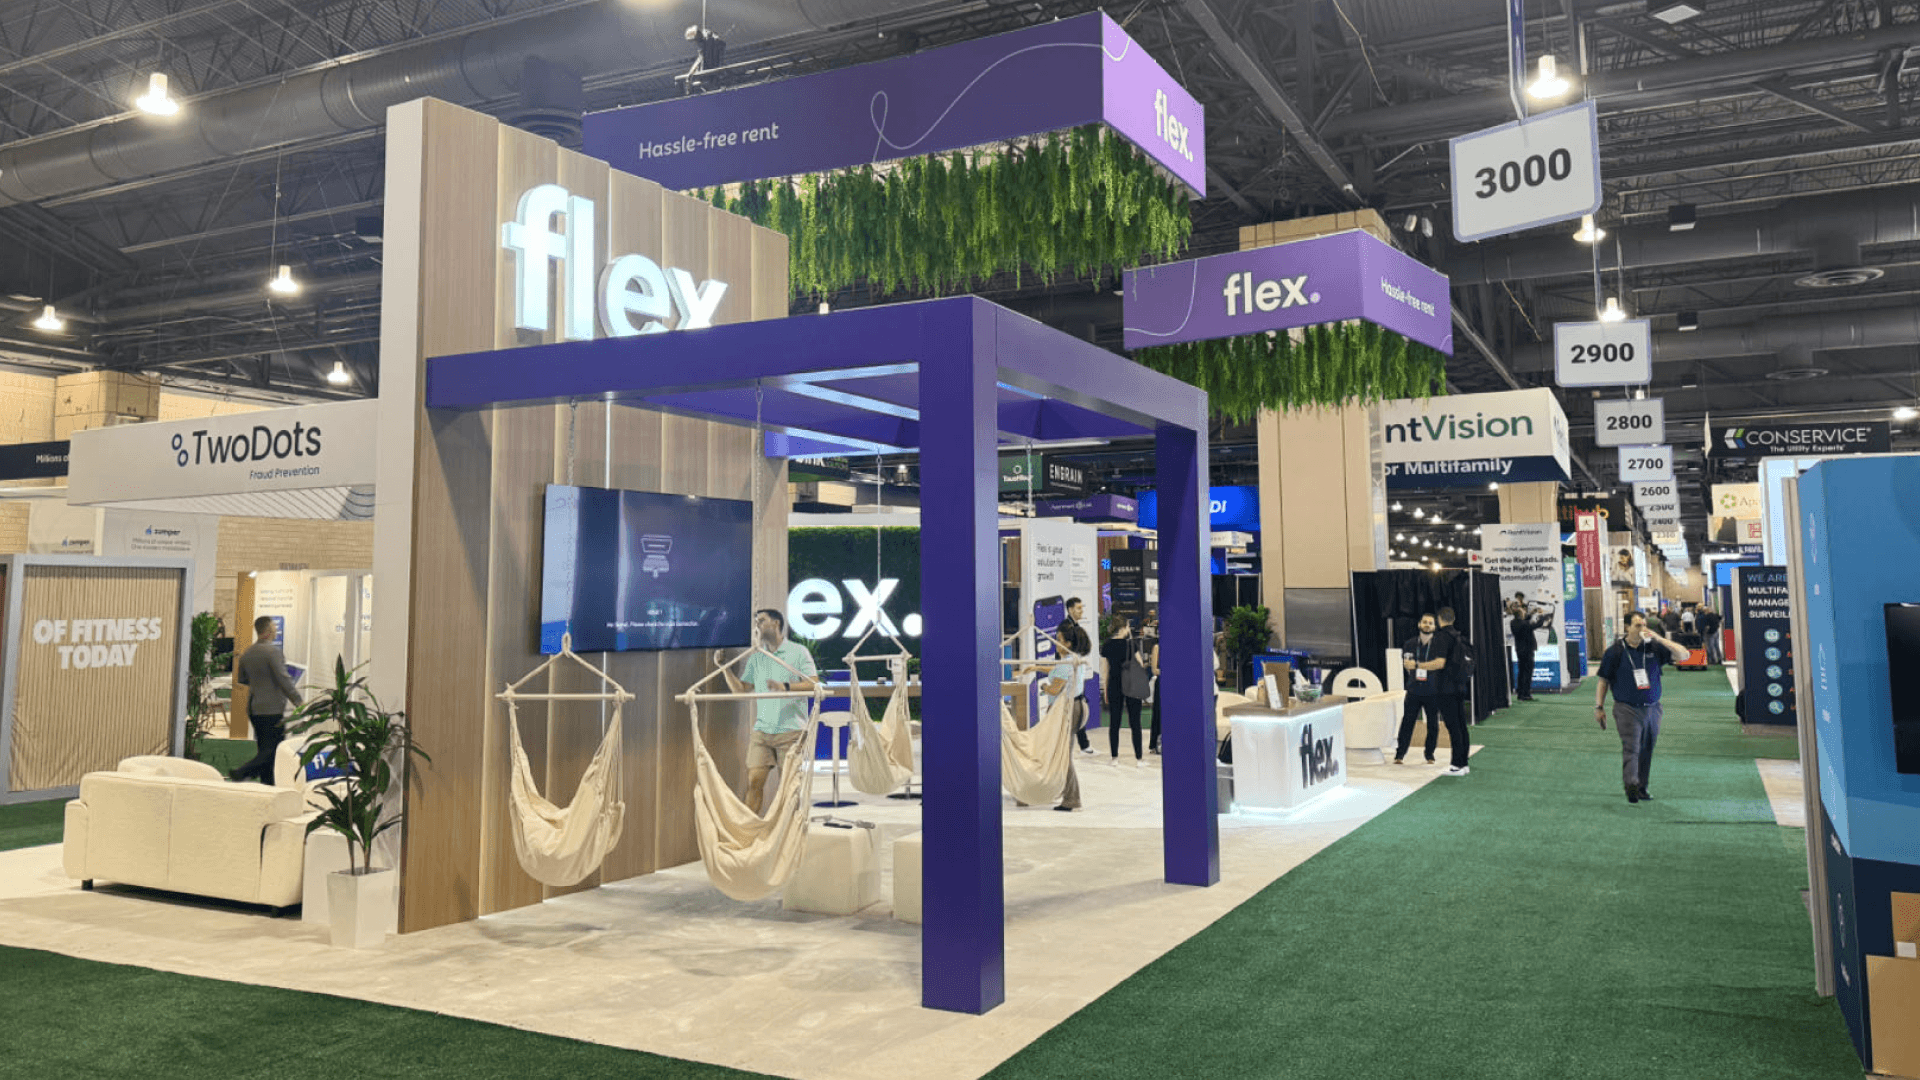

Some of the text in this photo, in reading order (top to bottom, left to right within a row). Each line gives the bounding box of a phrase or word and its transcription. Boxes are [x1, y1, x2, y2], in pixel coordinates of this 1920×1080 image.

[1153, 88, 1194, 162] flex.
[638, 121, 779, 159] Hassle-free rent
[1474, 147, 1572, 199] 3000
[1223, 271, 1321, 316] flex.
[1380, 275, 1435, 317] Hassle-free rent
[1570, 342, 1635, 364] 2900
[1385, 412, 1533, 443] ntVision
[1606, 414, 1652, 430] 2800
[192, 421, 321, 465] TwoDots
[249, 465, 320, 480] Fraud Prevention
[1405, 458, 1513, 475] Multifamily
[1627, 458, 1664, 469] 2700
[1641, 486, 1670, 496] 2600
[1513, 557, 1534, 565] Right
[1513, 565, 1534, 573] Right
[1747, 574, 1765, 583] WE
[33, 617, 162, 644] OF FITNESS
[58, 643, 138, 670] TODAY
[1298, 723, 1340, 789] flex.
